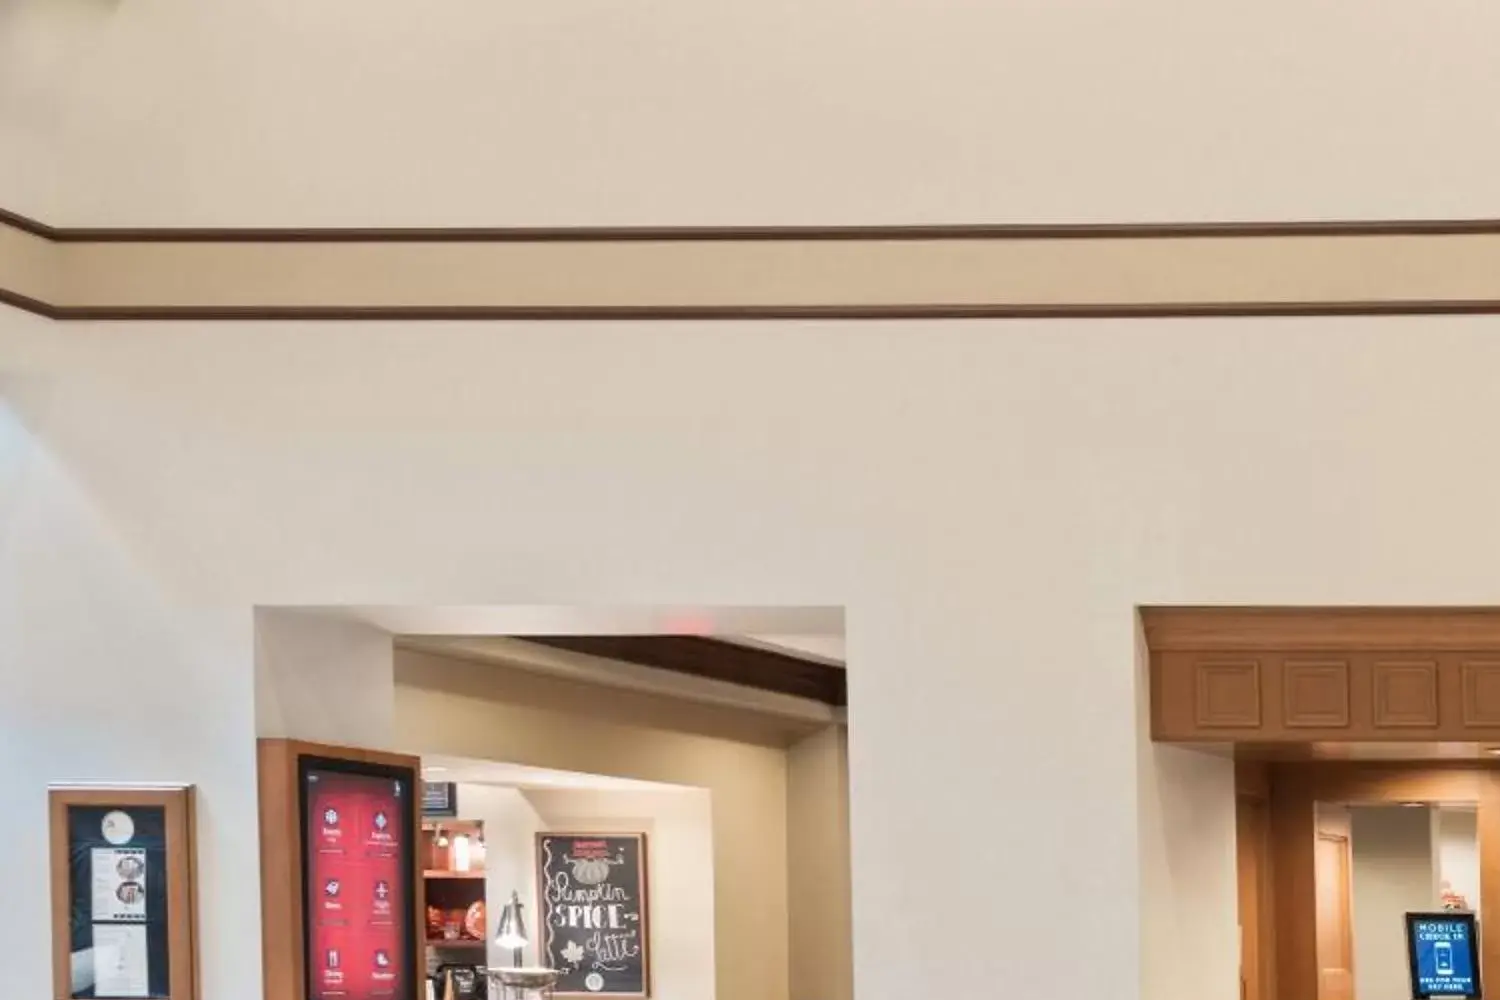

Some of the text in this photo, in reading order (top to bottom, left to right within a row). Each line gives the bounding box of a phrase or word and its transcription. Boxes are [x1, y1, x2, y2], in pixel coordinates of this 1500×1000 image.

[552, 871, 631, 906] Pumpkin
[554, 904, 627, 930] SPICE
[1419, 923, 1464, 932] MOBILE
[1419, 933, 1451, 941] CHECK
